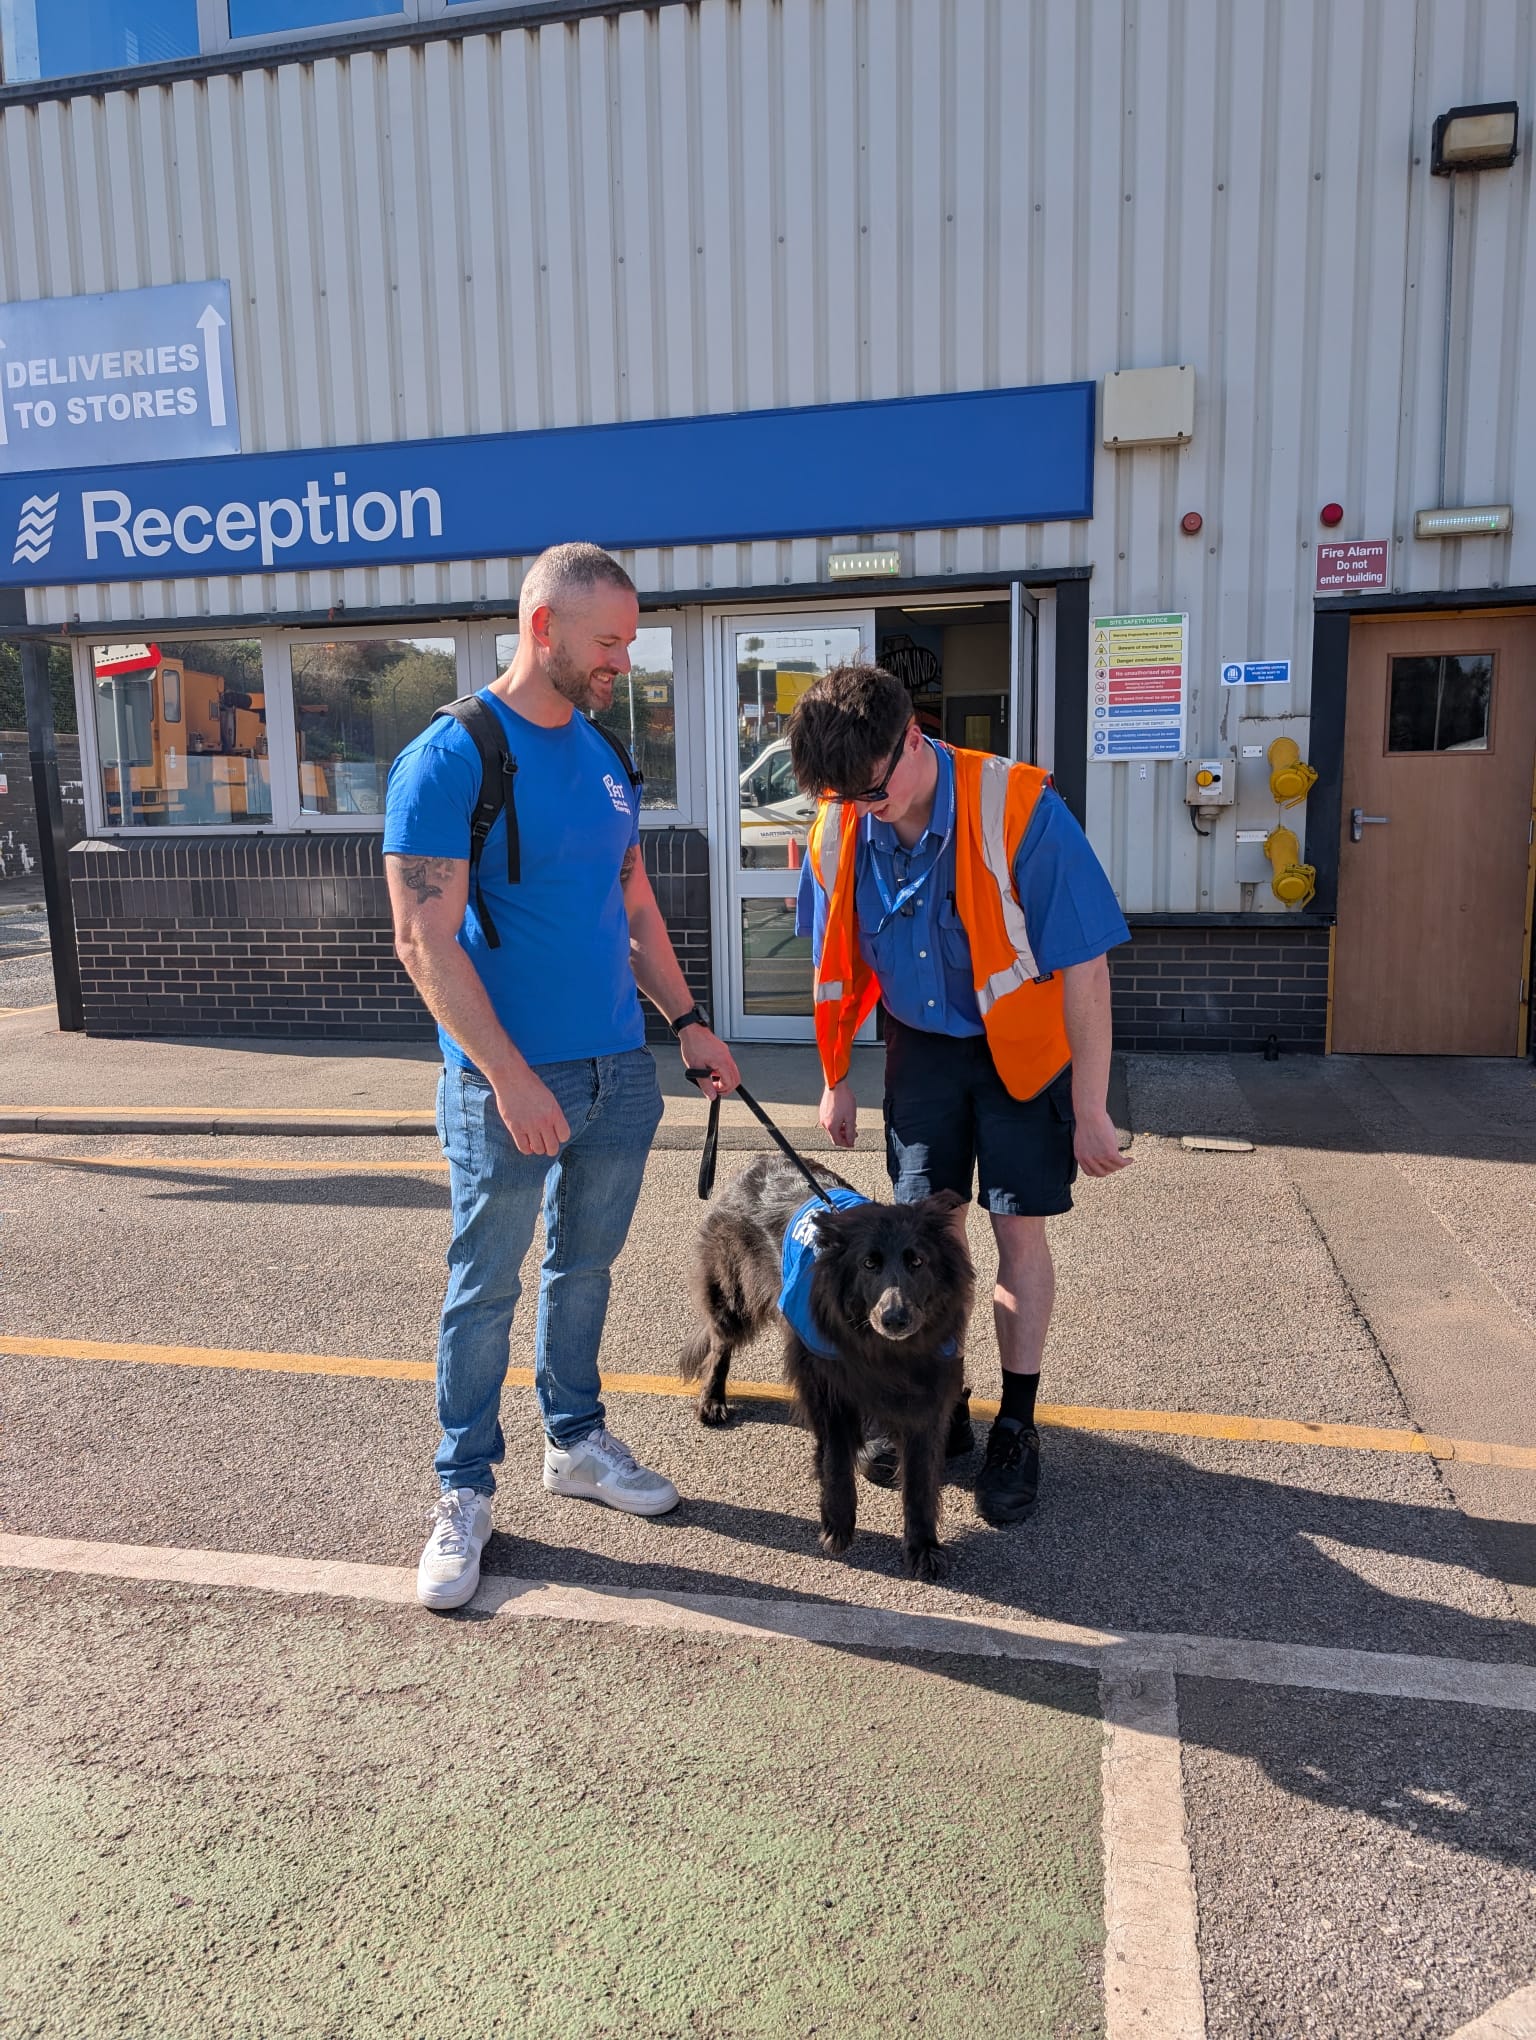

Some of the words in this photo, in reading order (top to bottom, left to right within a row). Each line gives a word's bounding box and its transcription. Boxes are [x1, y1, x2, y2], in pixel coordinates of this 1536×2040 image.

[6, 343, 200, 389] DELIVERIES
[13, 400, 57, 429] TO
[66, 386, 198, 425] STORES
[81, 471, 443, 566] Reception
[1321, 548, 1344, 559] Fire
[1347, 546, 1383, 557] Alarm
[1336, 560, 1350, 570] Do
[1352, 559, 1368, 569] not
[1320, 574, 1344, 585] enter
[1346, 572, 1383, 583] building
